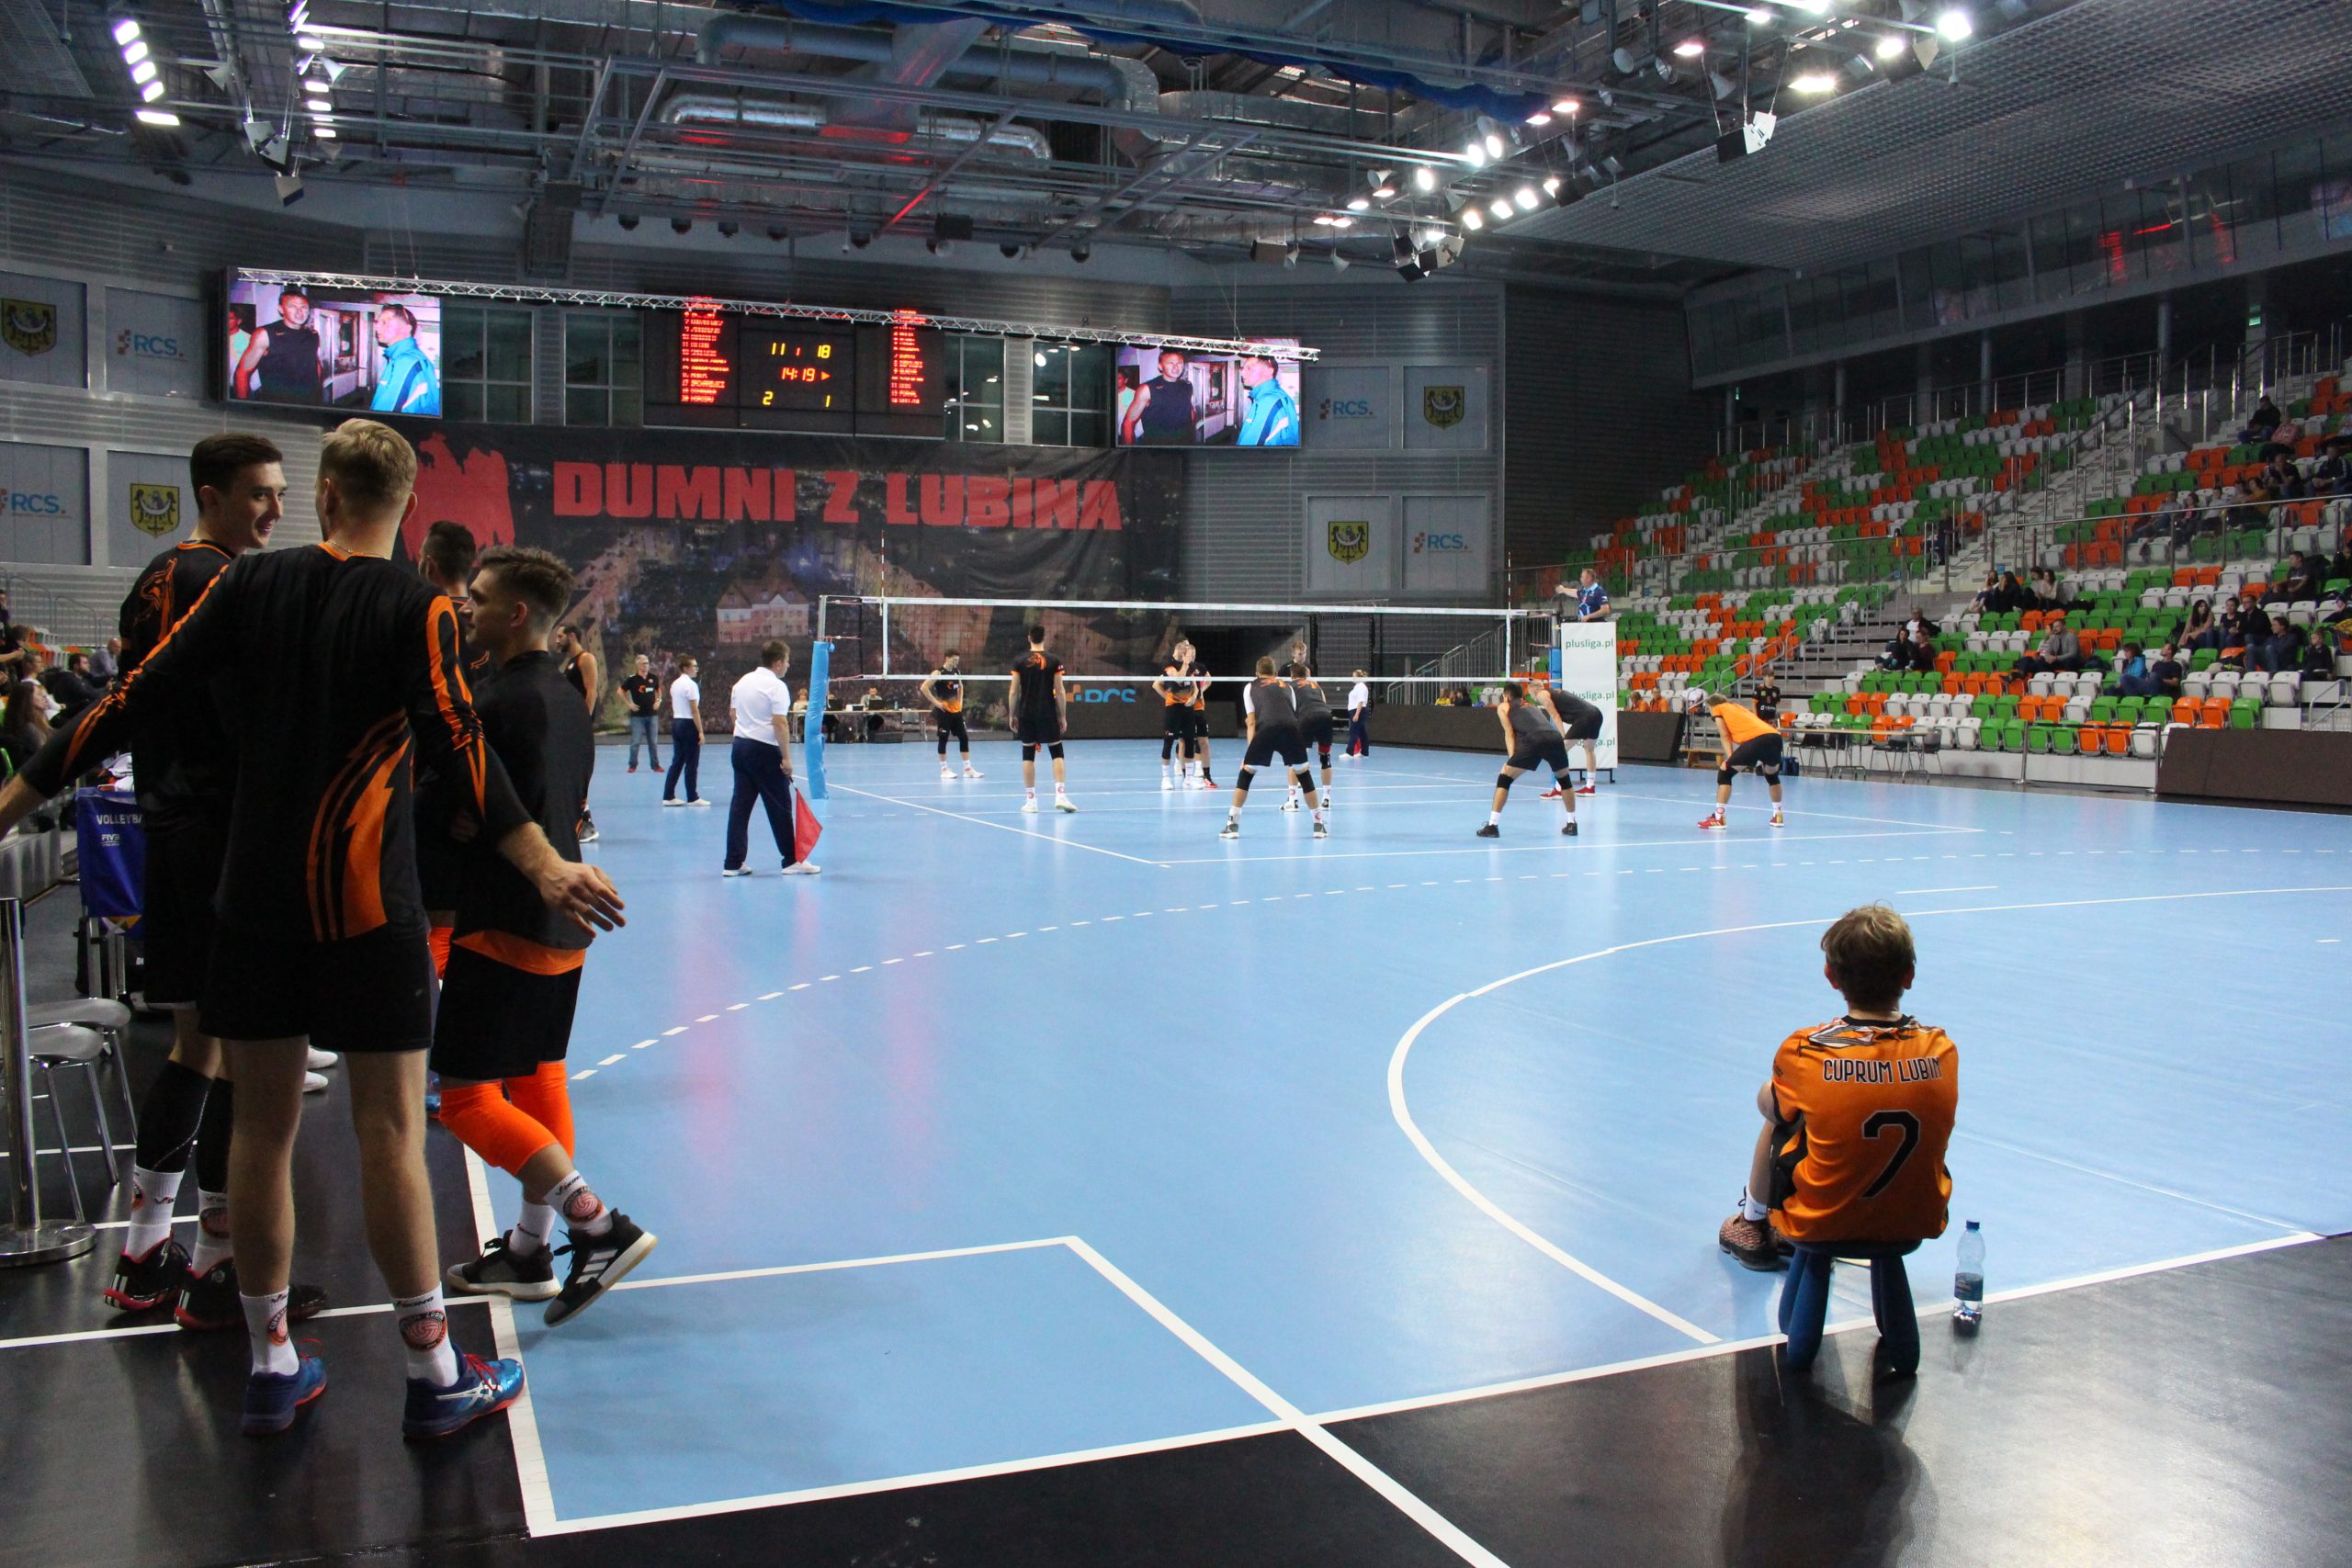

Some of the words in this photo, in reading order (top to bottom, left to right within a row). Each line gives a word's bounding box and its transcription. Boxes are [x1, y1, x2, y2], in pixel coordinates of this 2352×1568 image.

[771, 342, 786, 355] 11
[817, 344, 831, 359] 18
[781, 367, 816, 382] 14:19
[763, 390, 774, 406] 2
[825, 395, 831, 408] 1
[553, 461, 796, 522] DUMNI
[822, 470, 859, 524] Z
[886, 472, 1123, 530] LUBINA
[1565, 638, 1614, 649] plusliga.pl
[1823, 1058, 1894, 1084] CUPRUM
